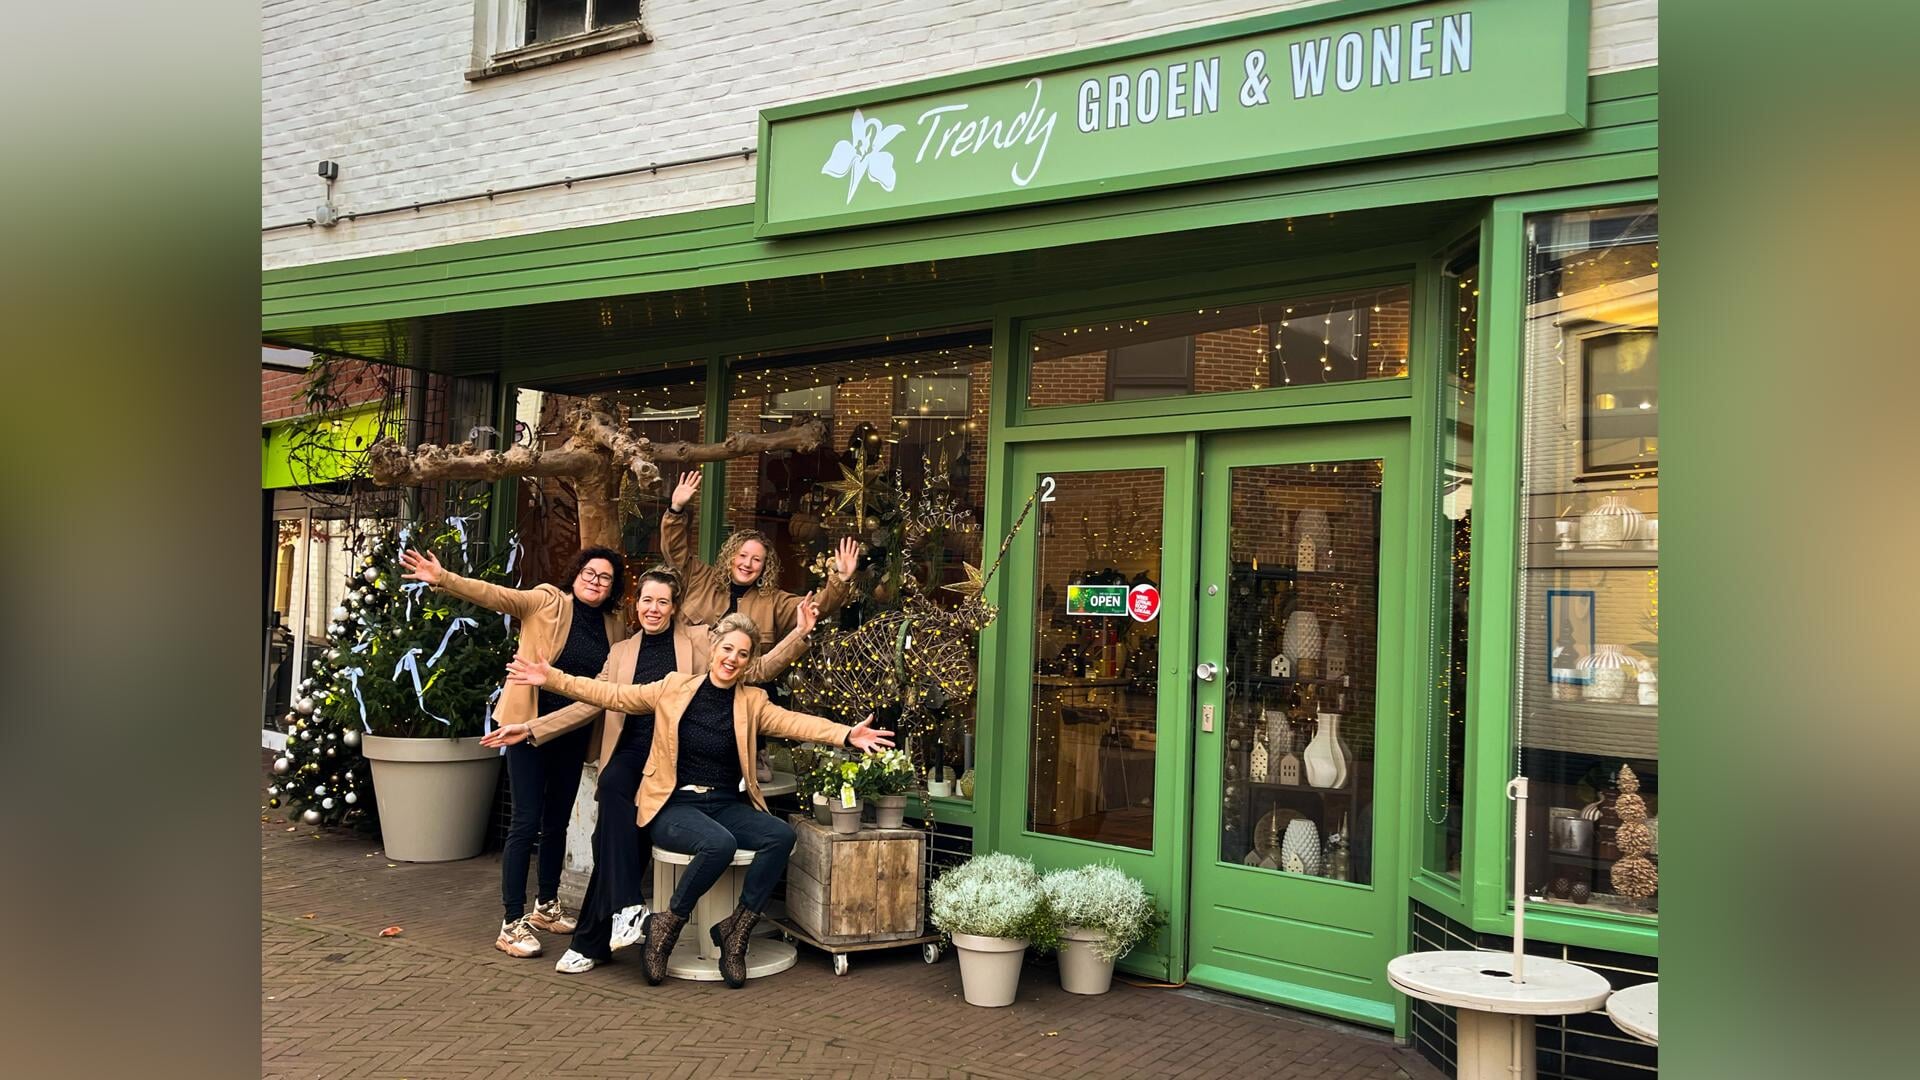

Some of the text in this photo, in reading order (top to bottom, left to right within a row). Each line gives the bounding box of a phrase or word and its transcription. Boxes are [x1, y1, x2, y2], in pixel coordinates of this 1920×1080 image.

[915, 12, 1472, 189] Trendy GROEN & WONEN
[1040, 476, 1056, 503] 2
[1090, 595, 1121, 607] OPEN
